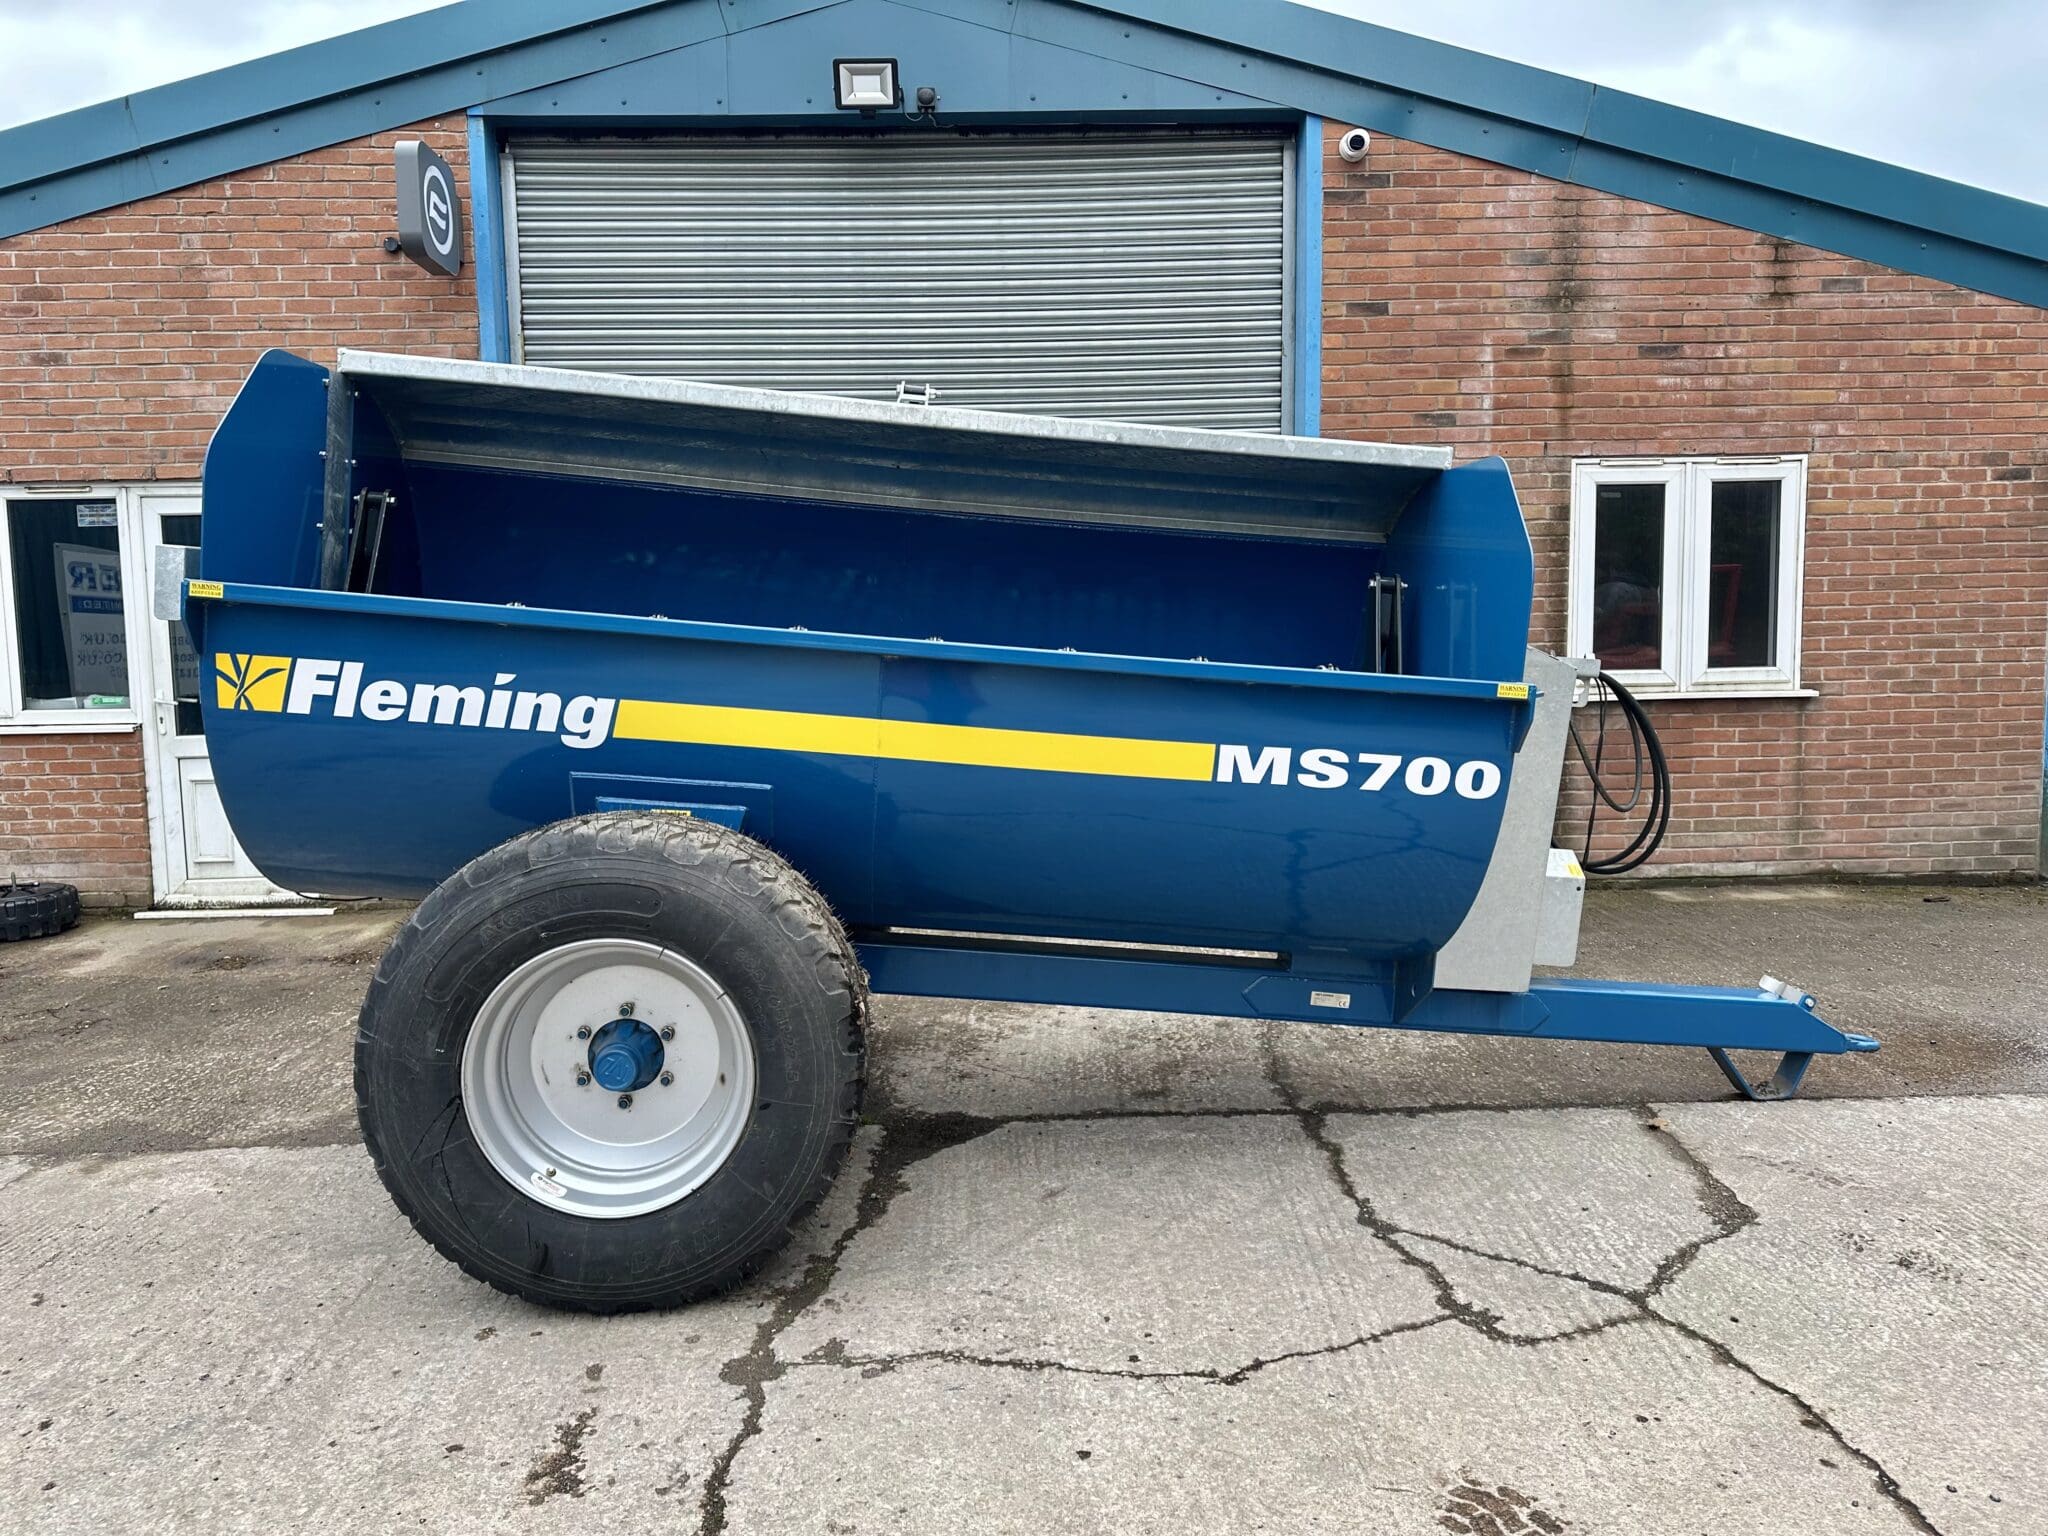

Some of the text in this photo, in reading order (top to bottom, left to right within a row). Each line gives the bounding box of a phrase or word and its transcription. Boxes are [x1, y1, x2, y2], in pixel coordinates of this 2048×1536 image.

[191, 583, 221, 591] WARNING
[286, 657, 616, 749] Fleming
[1216, 744, 1501, 800] MS700
